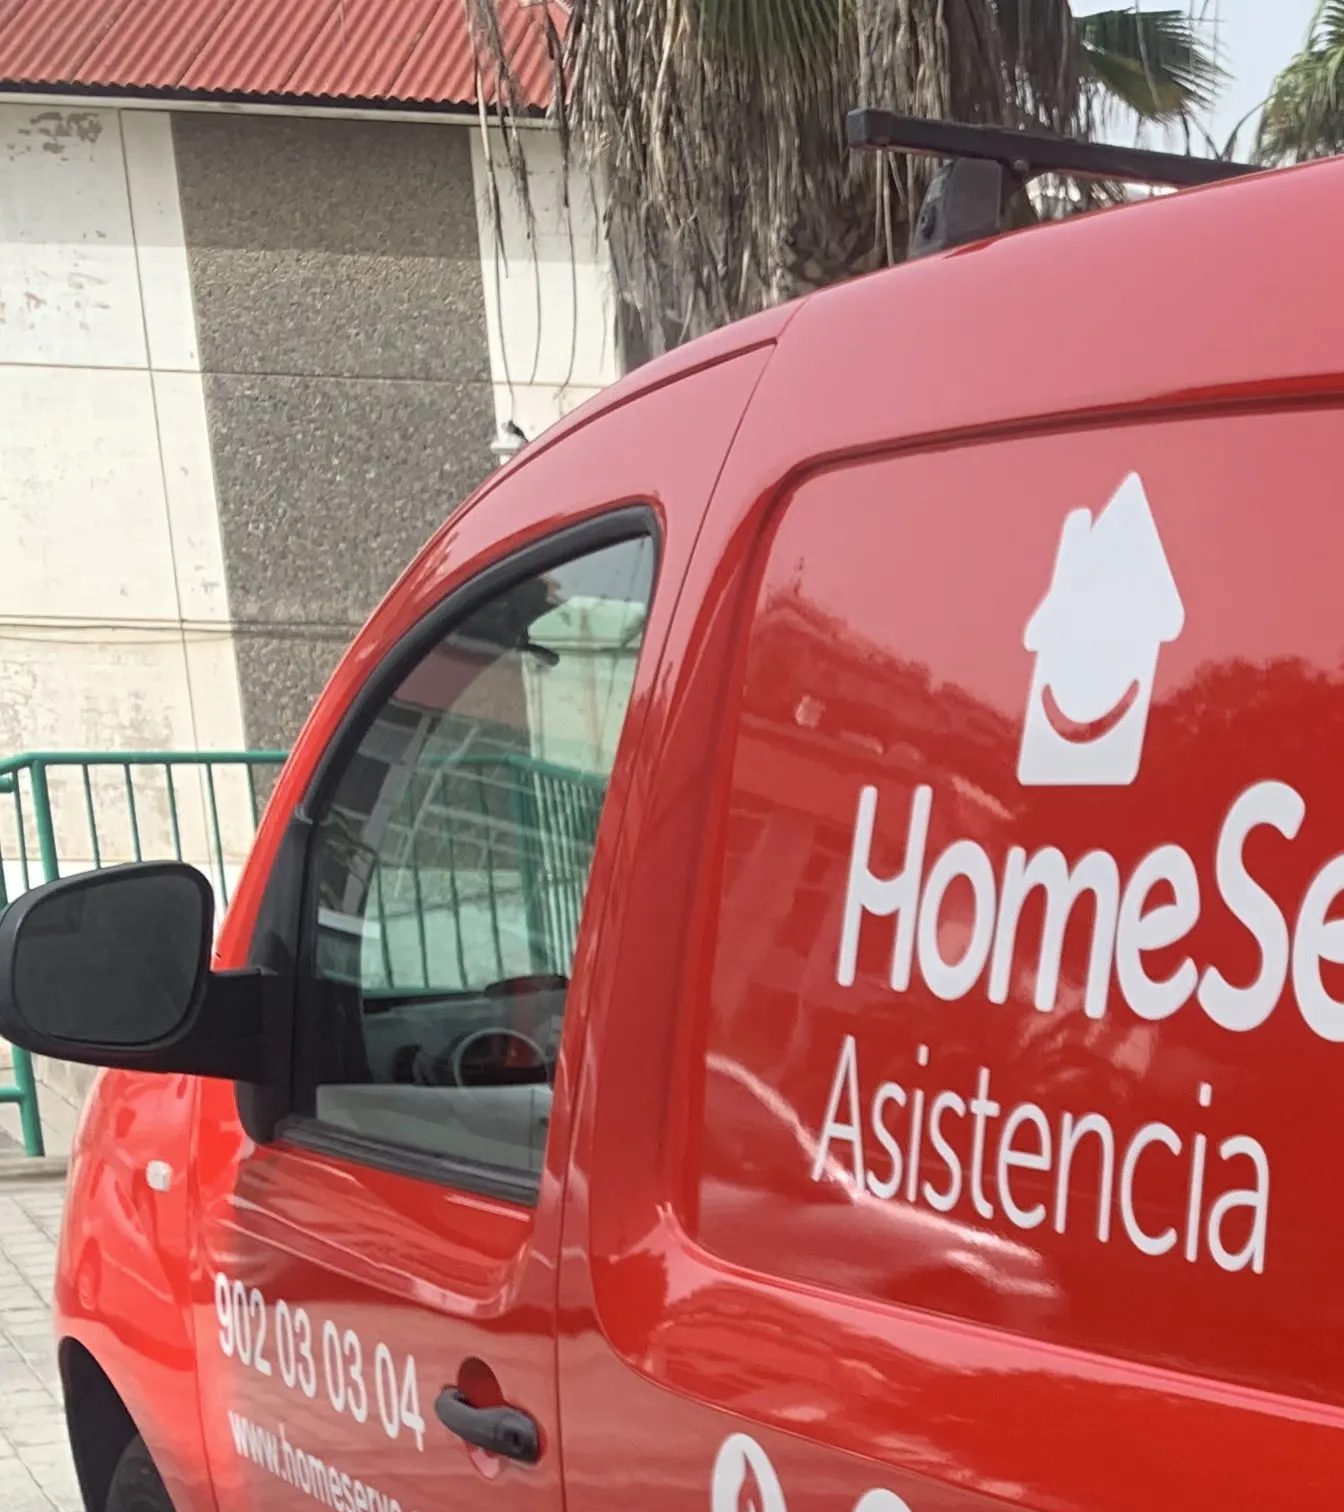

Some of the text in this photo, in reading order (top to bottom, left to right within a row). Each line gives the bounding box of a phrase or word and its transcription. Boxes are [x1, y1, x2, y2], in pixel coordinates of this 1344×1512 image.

[811, 1034, 1271, 1274] Asistencia
[214, 1271, 426, 1453] 902 03 03 04
